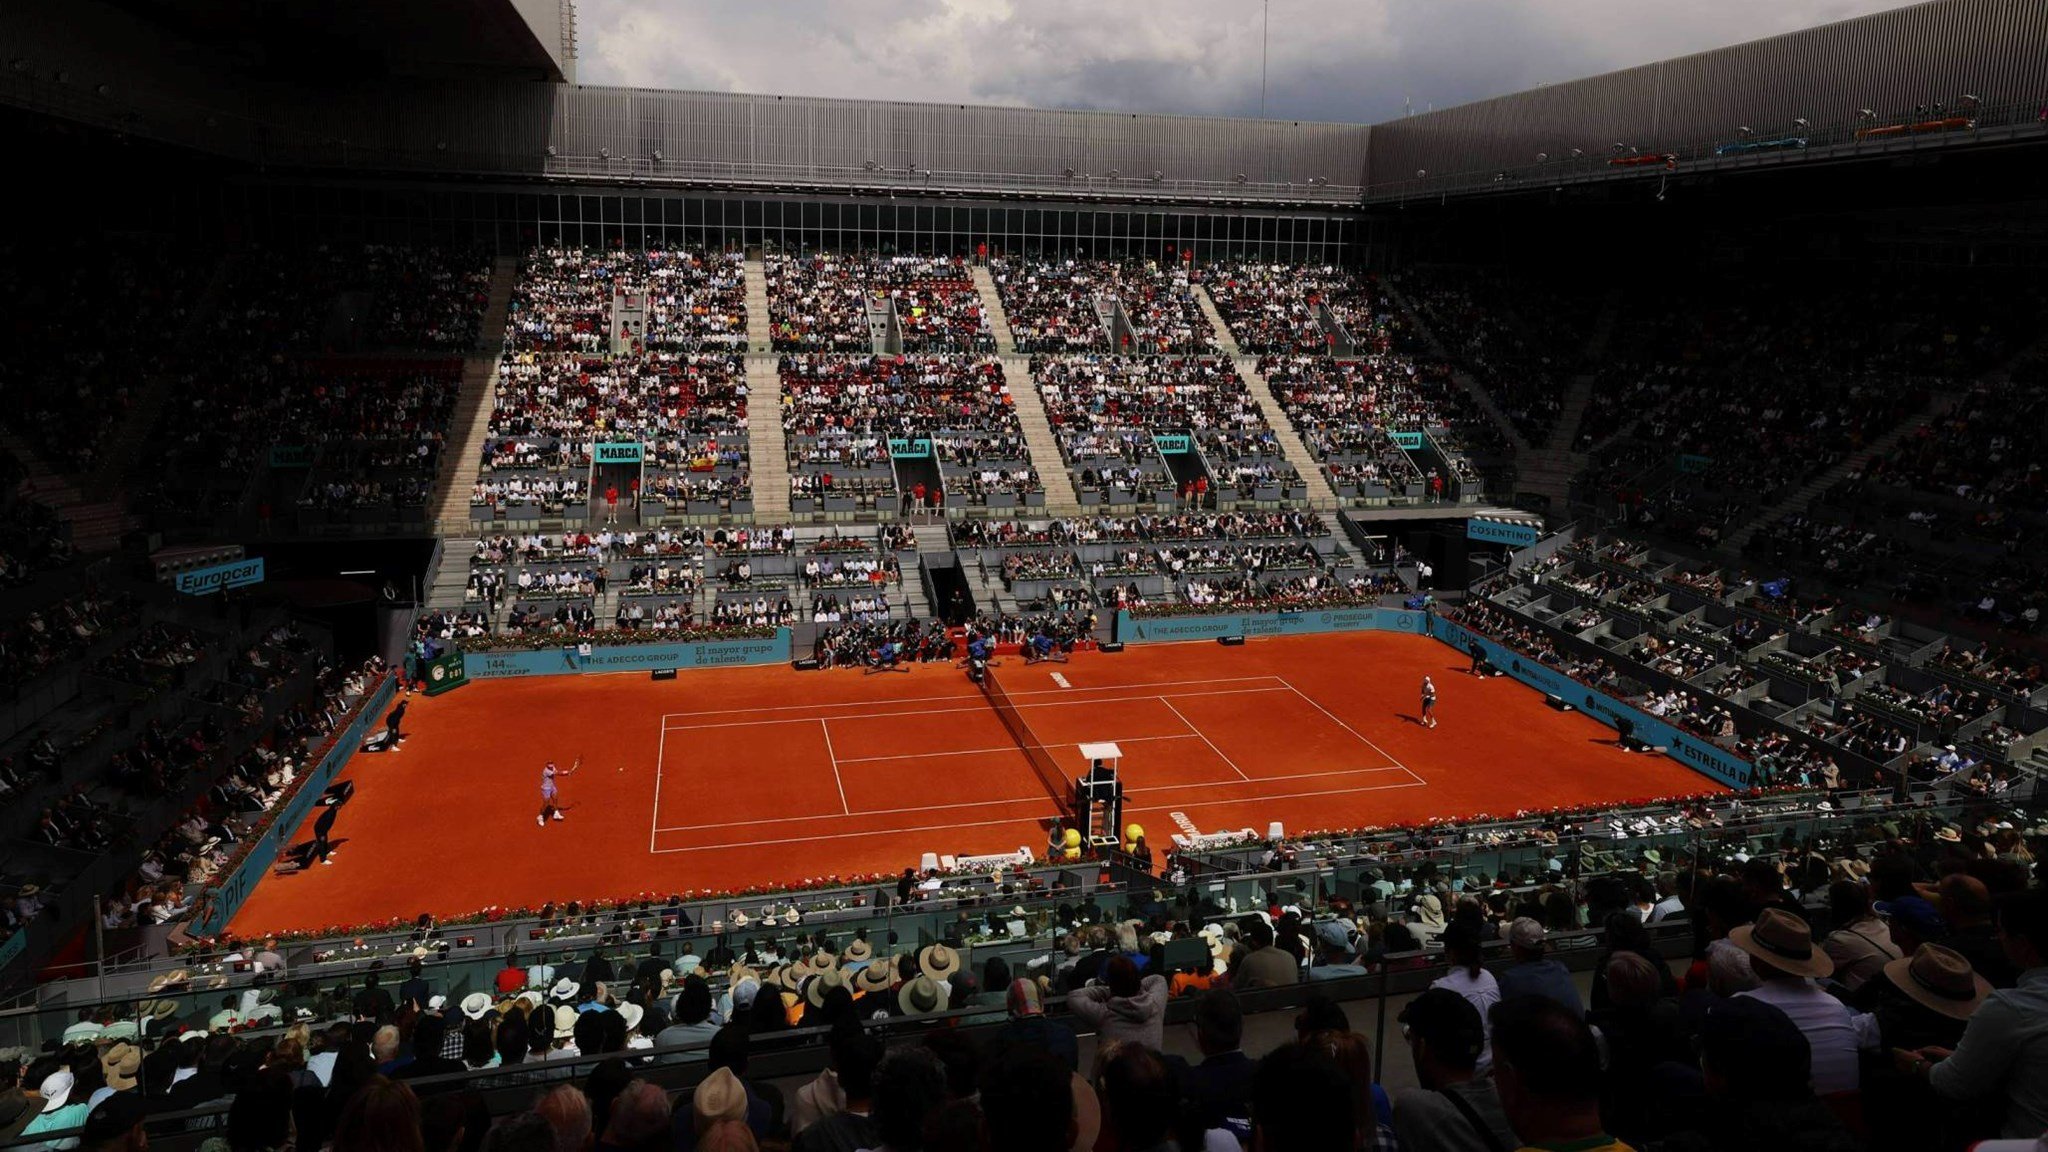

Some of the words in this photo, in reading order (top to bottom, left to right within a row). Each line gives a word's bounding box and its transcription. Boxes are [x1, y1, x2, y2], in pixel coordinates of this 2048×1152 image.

[600, 447, 640, 459] MARCA
[1470, 525, 1531, 541] COSENTINO
[182, 564, 259, 590] Europcar
[1170, 626, 1201, 634] ADECCO
[1202, 624, 1229, 632] GROUP
[695, 646, 706, 655] El
[708, 647, 740, 655] mayor
[743, 645, 773, 654] grupo
[487, 660, 505, 669] 144
[587, 657, 604, 665] THE
[607, 654, 645, 664] ADECCO
[646, 653, 679, 661] GROUP
[695, 655, 708, 664] de
[710, 655, 747, 663] talento
[482, 669, 530, 677] DUNLOP
[1684, 745, 1737, 778] ESTRELLA
[225, 867, 247, 916] PIF
